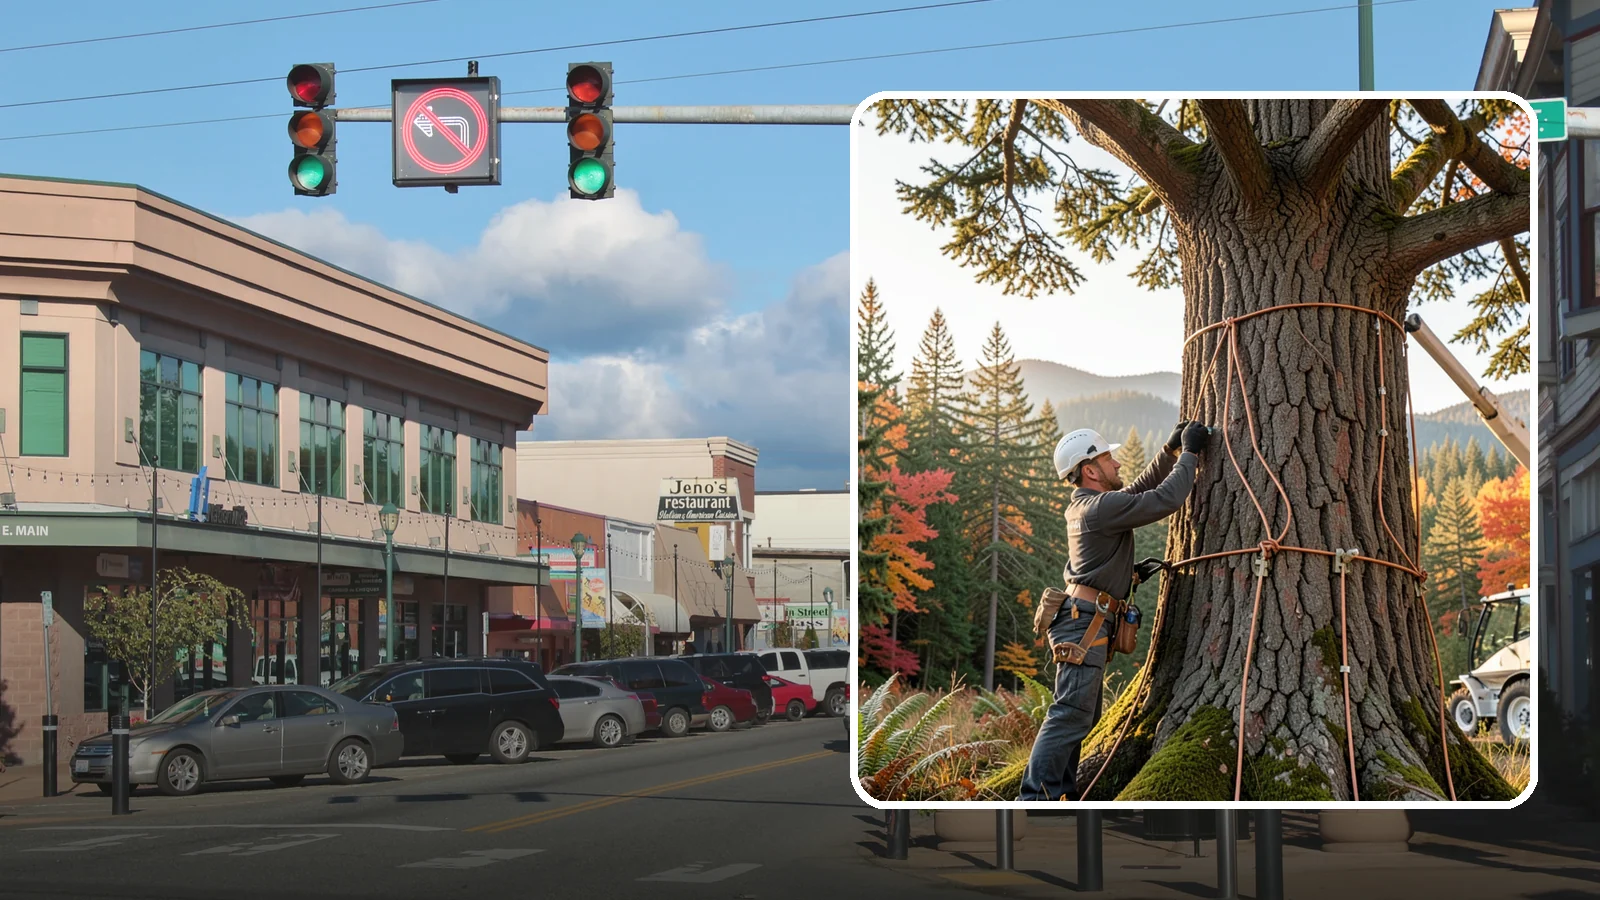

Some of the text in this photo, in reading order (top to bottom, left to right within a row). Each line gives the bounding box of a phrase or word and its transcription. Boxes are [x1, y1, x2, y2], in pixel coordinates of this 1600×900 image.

[669, 480, 728, 495] Jeno's
[665, 496, 731, 509] restaurant
[658, 509, 681, 520] Italian
[686, 509, 715, 519] American
[715, 509, 738, 519] Cuisine
[2, 525, 49, 536] E. MAIN
[785, 607, 829, 617] in Street
[789, 619, 824, 627] lass
